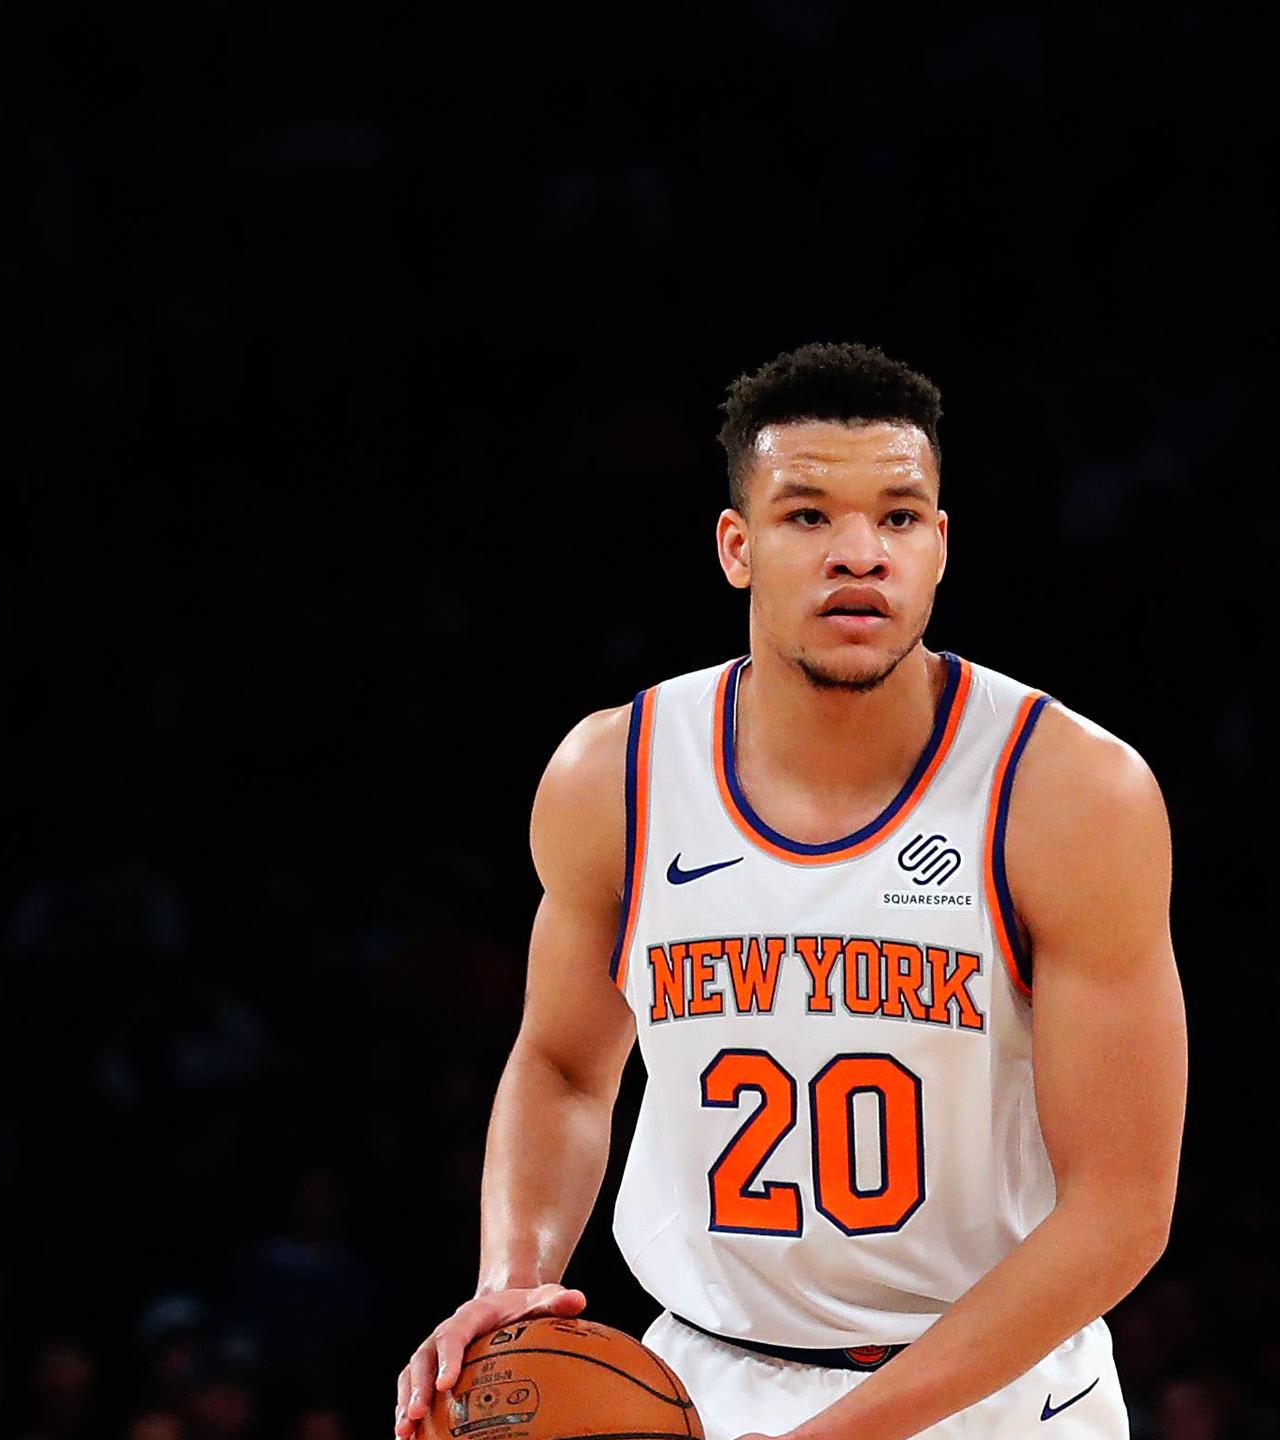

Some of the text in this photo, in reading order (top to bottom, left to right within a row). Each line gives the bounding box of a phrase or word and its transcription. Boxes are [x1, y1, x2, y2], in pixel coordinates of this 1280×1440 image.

[883, 893, 972, 906] SQUARESPACE
[647, 934, 988, 1034] NEW YORK
[700, 1048, 927, 1238] 20
